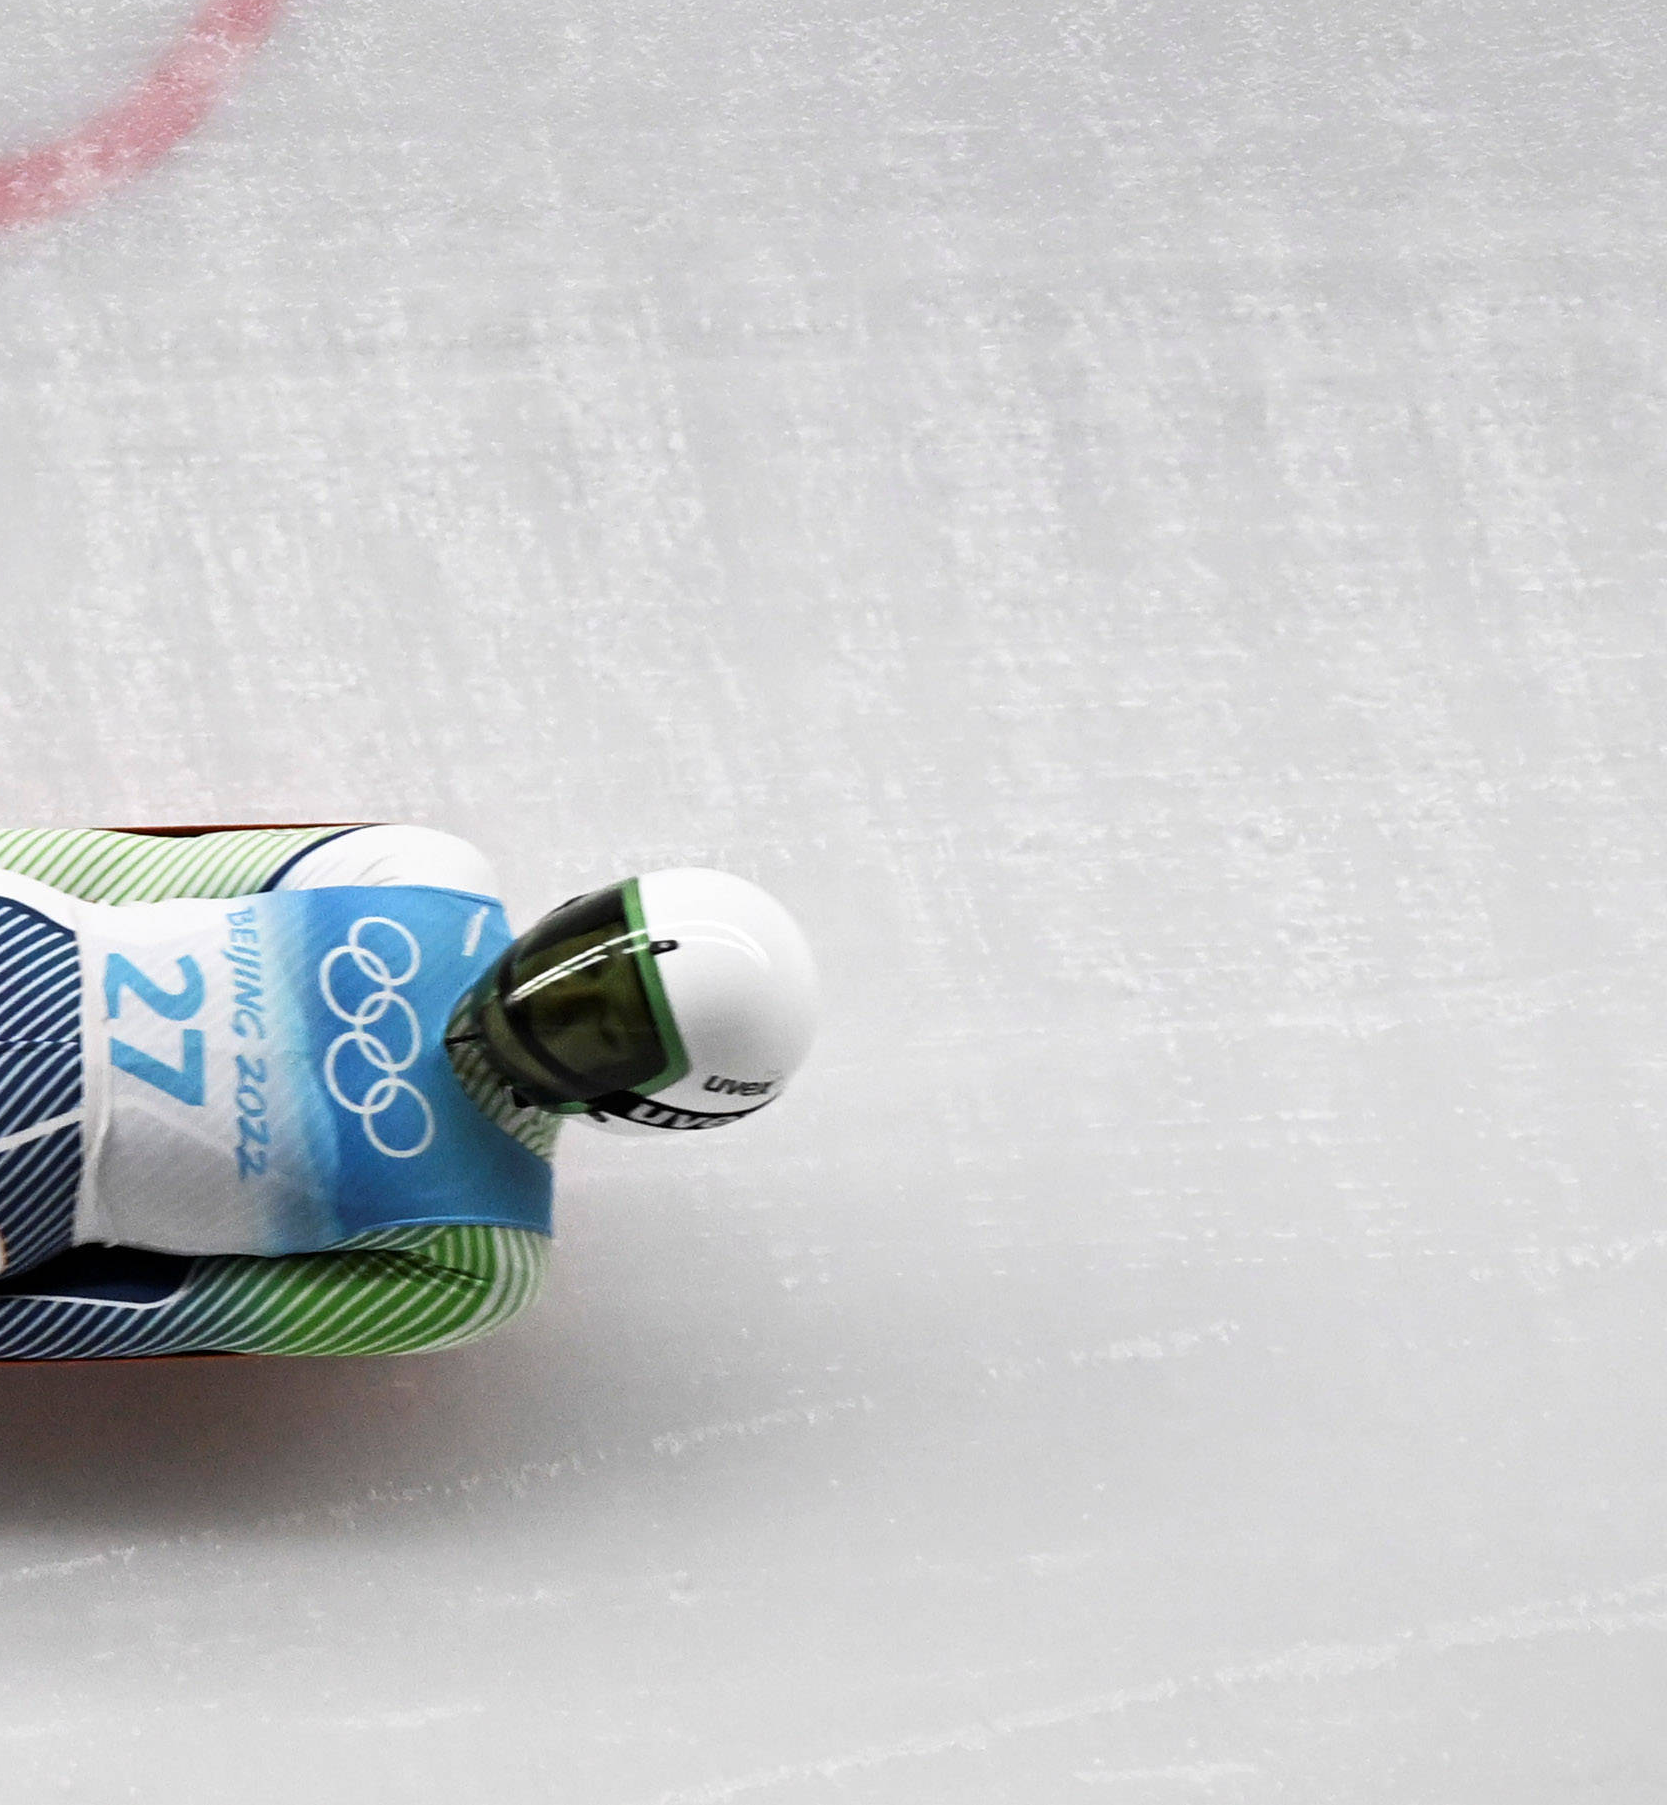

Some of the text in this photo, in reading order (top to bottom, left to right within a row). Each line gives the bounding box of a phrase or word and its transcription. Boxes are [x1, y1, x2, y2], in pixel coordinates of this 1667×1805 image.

[105, 953, 205, 1106] 27
[223, 907, 270, 1180] BEIJING 2022
